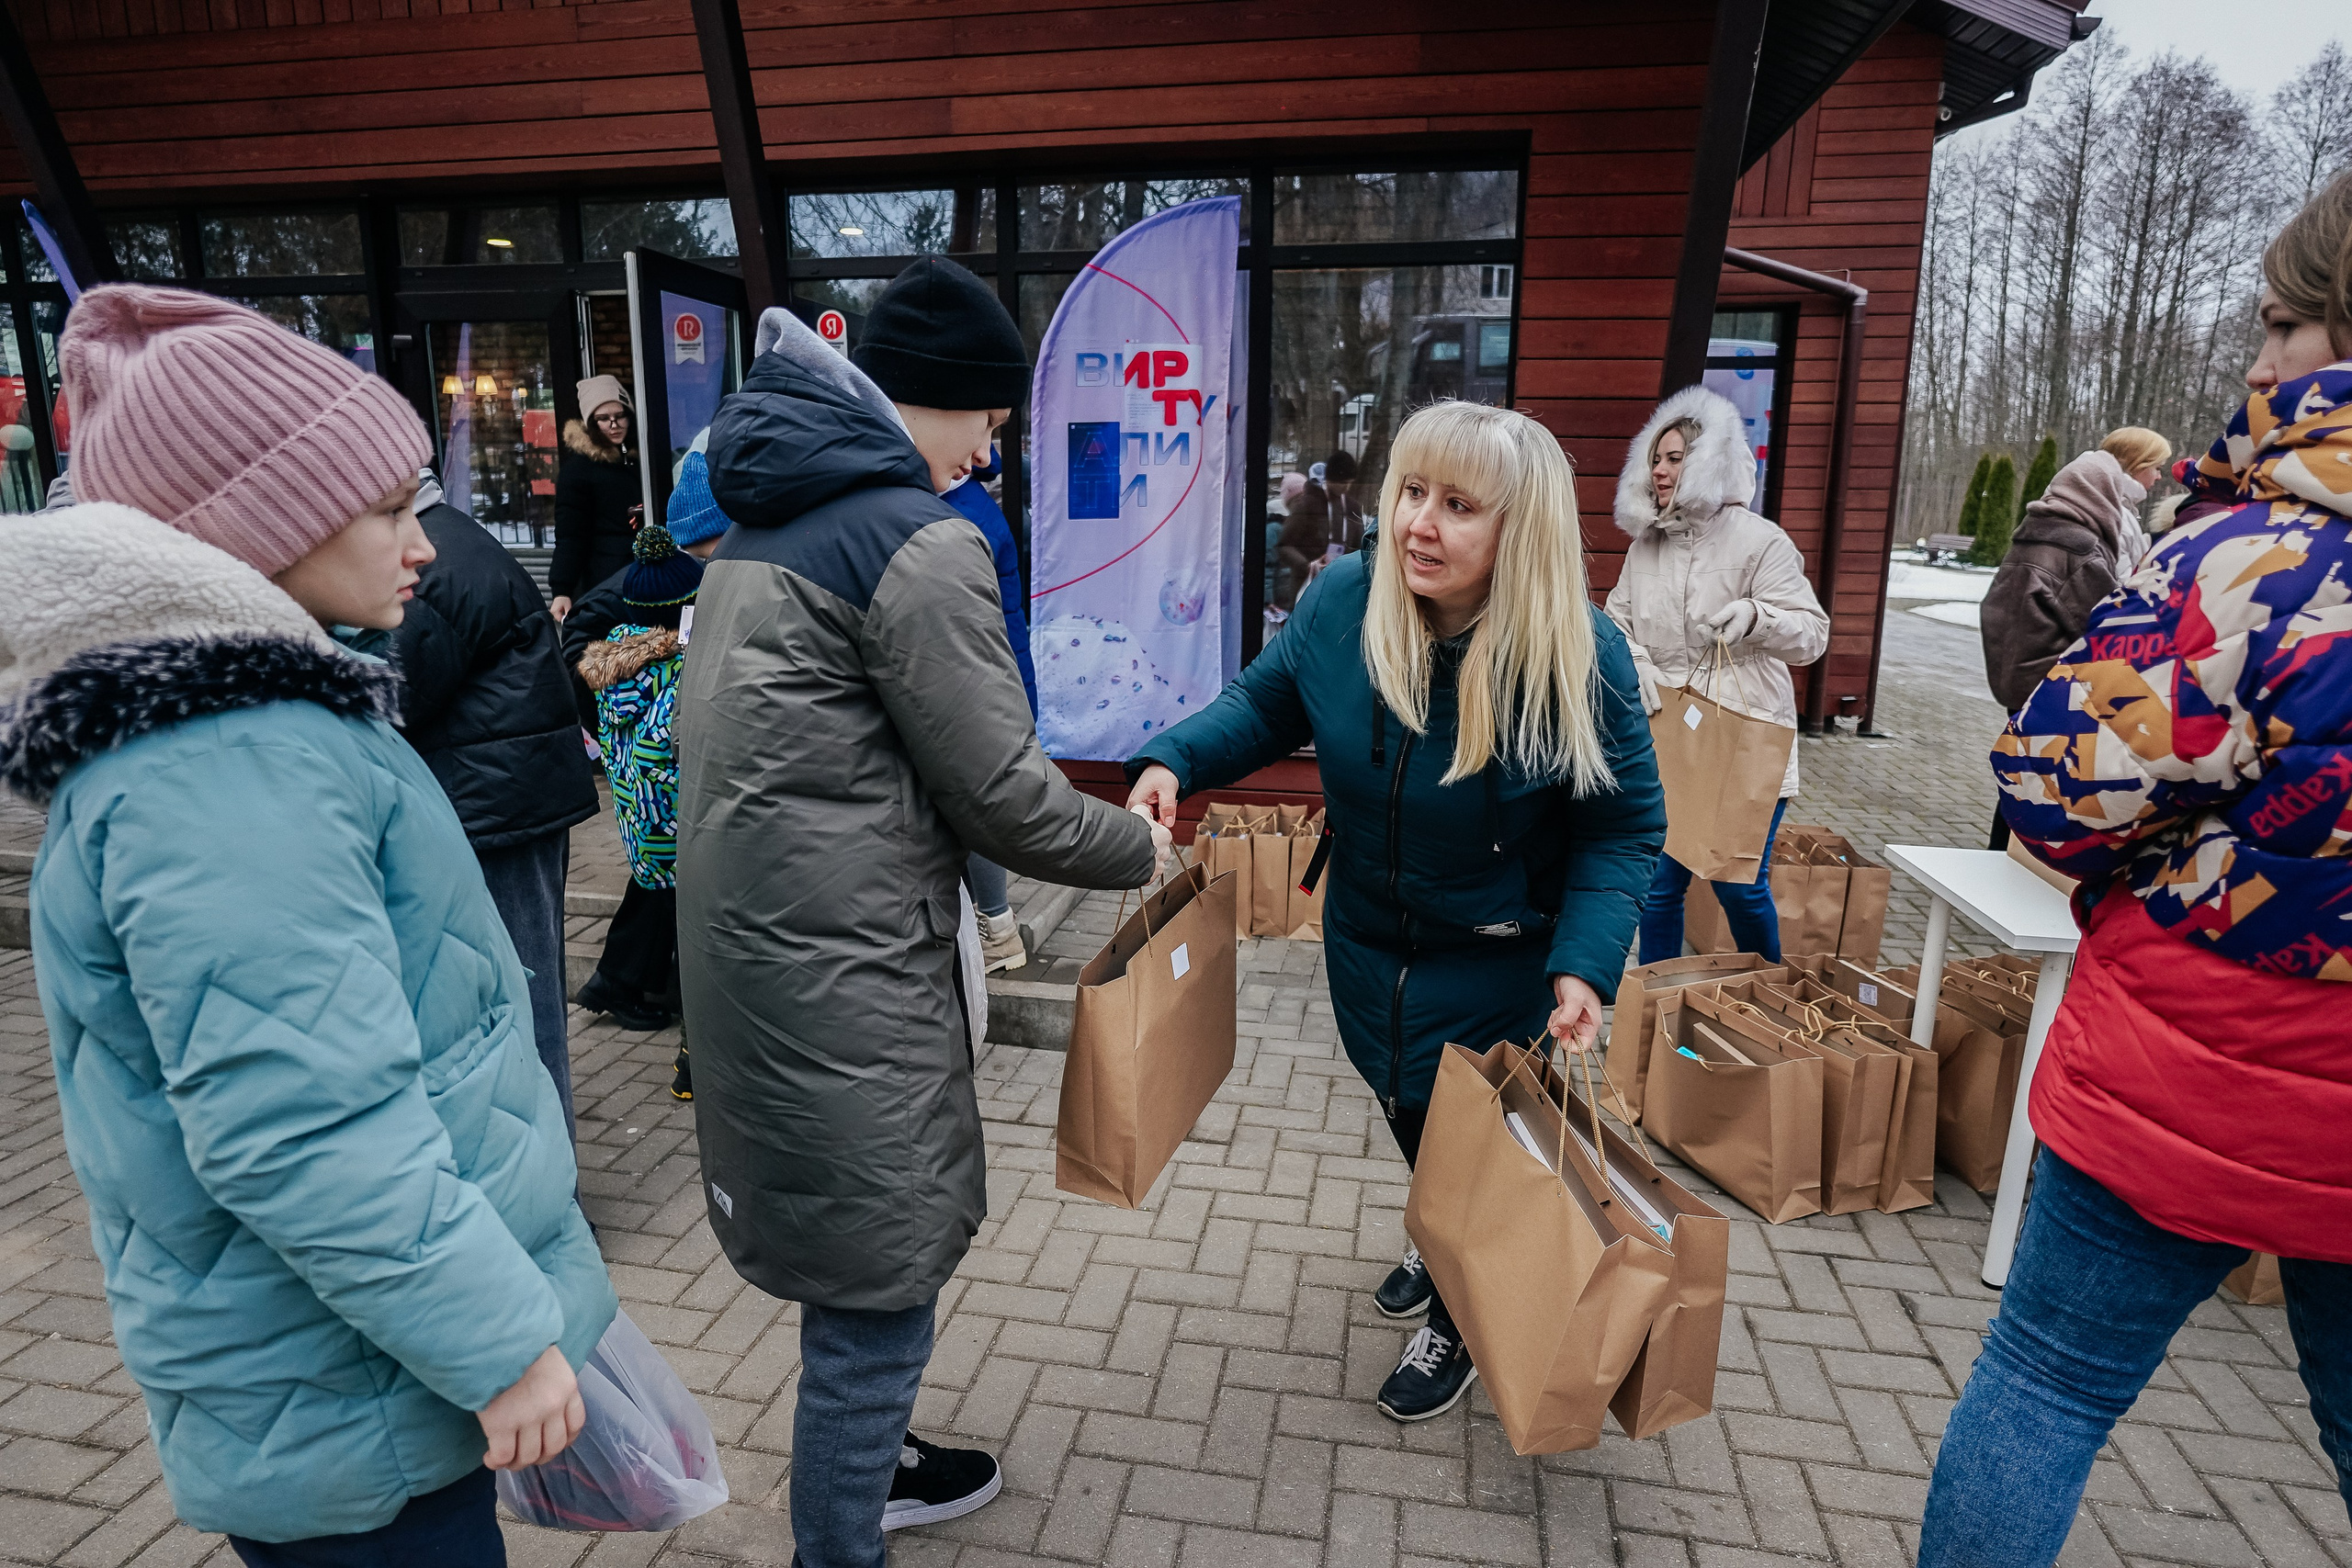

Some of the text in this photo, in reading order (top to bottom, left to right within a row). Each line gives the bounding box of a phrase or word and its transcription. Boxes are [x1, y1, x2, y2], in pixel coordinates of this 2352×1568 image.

[825, 318, 837, 335] Я
[1076, 351, 1189, 389] ВИР
[1152, 389, 1217, 426] ТУ
[2249, 752, 2352, 838] Kappa
